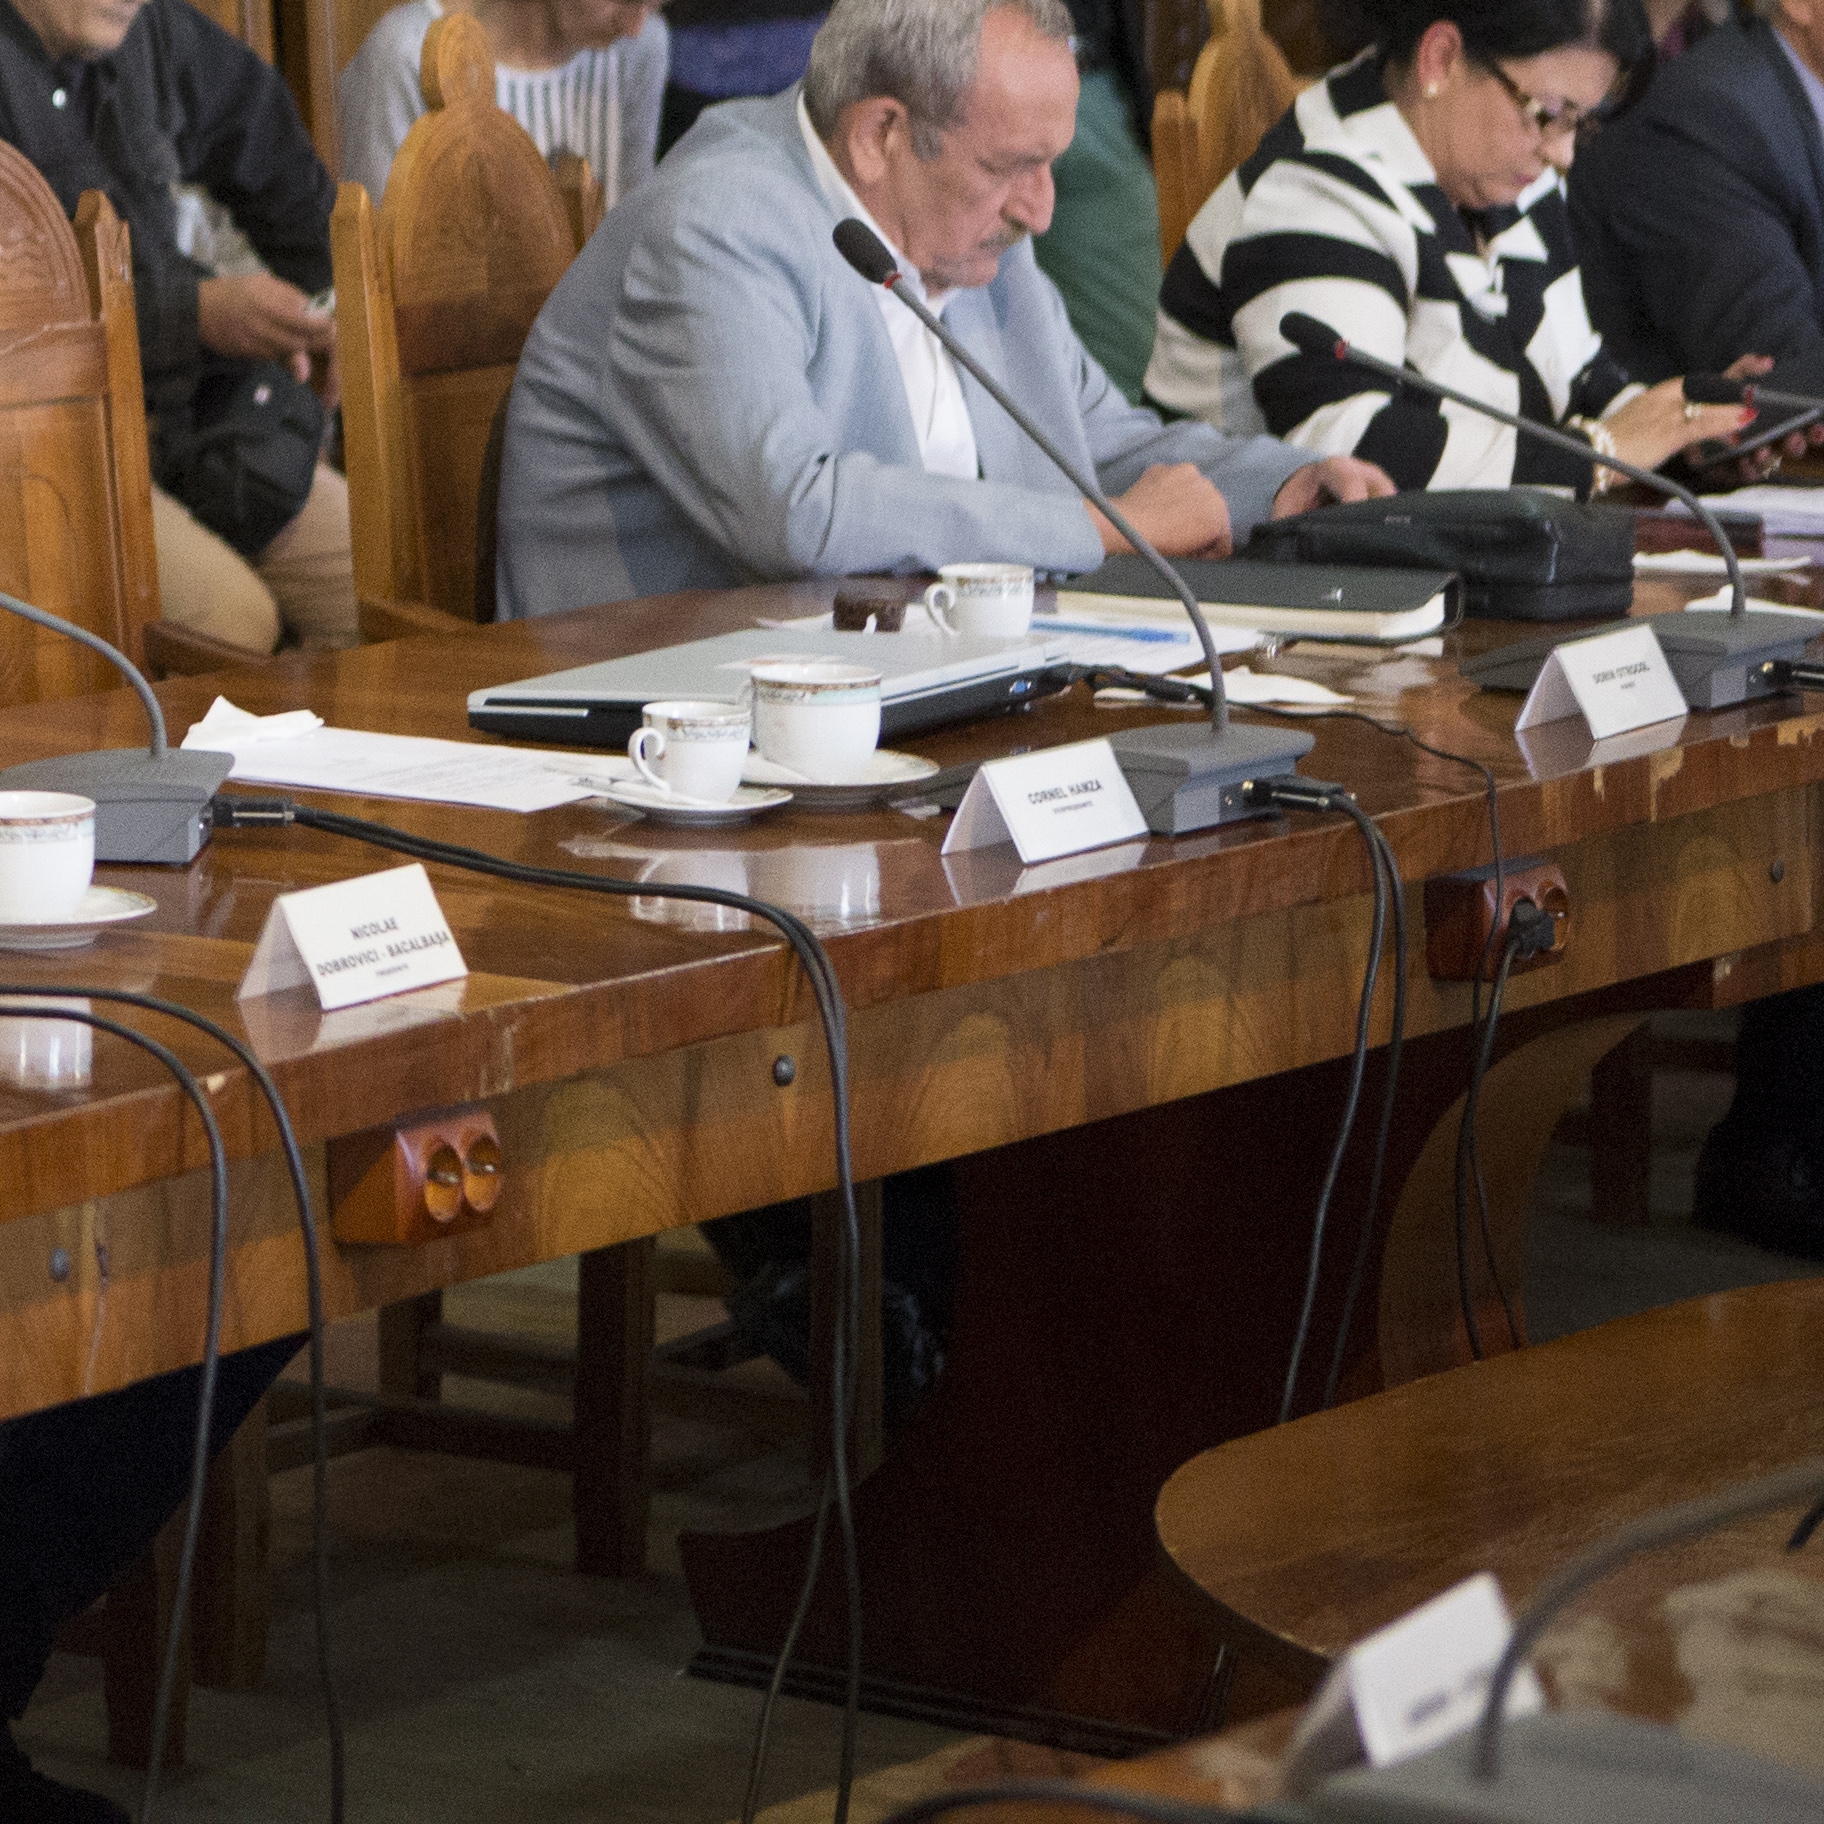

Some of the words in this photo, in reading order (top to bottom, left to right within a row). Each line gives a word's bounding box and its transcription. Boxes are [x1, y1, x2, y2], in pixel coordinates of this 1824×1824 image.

[1027, 787, 1068, 805] CORNEL
[349, 917, 399, 940] NICOLAE
[315, 950, 381, 976] DOBROVICI
